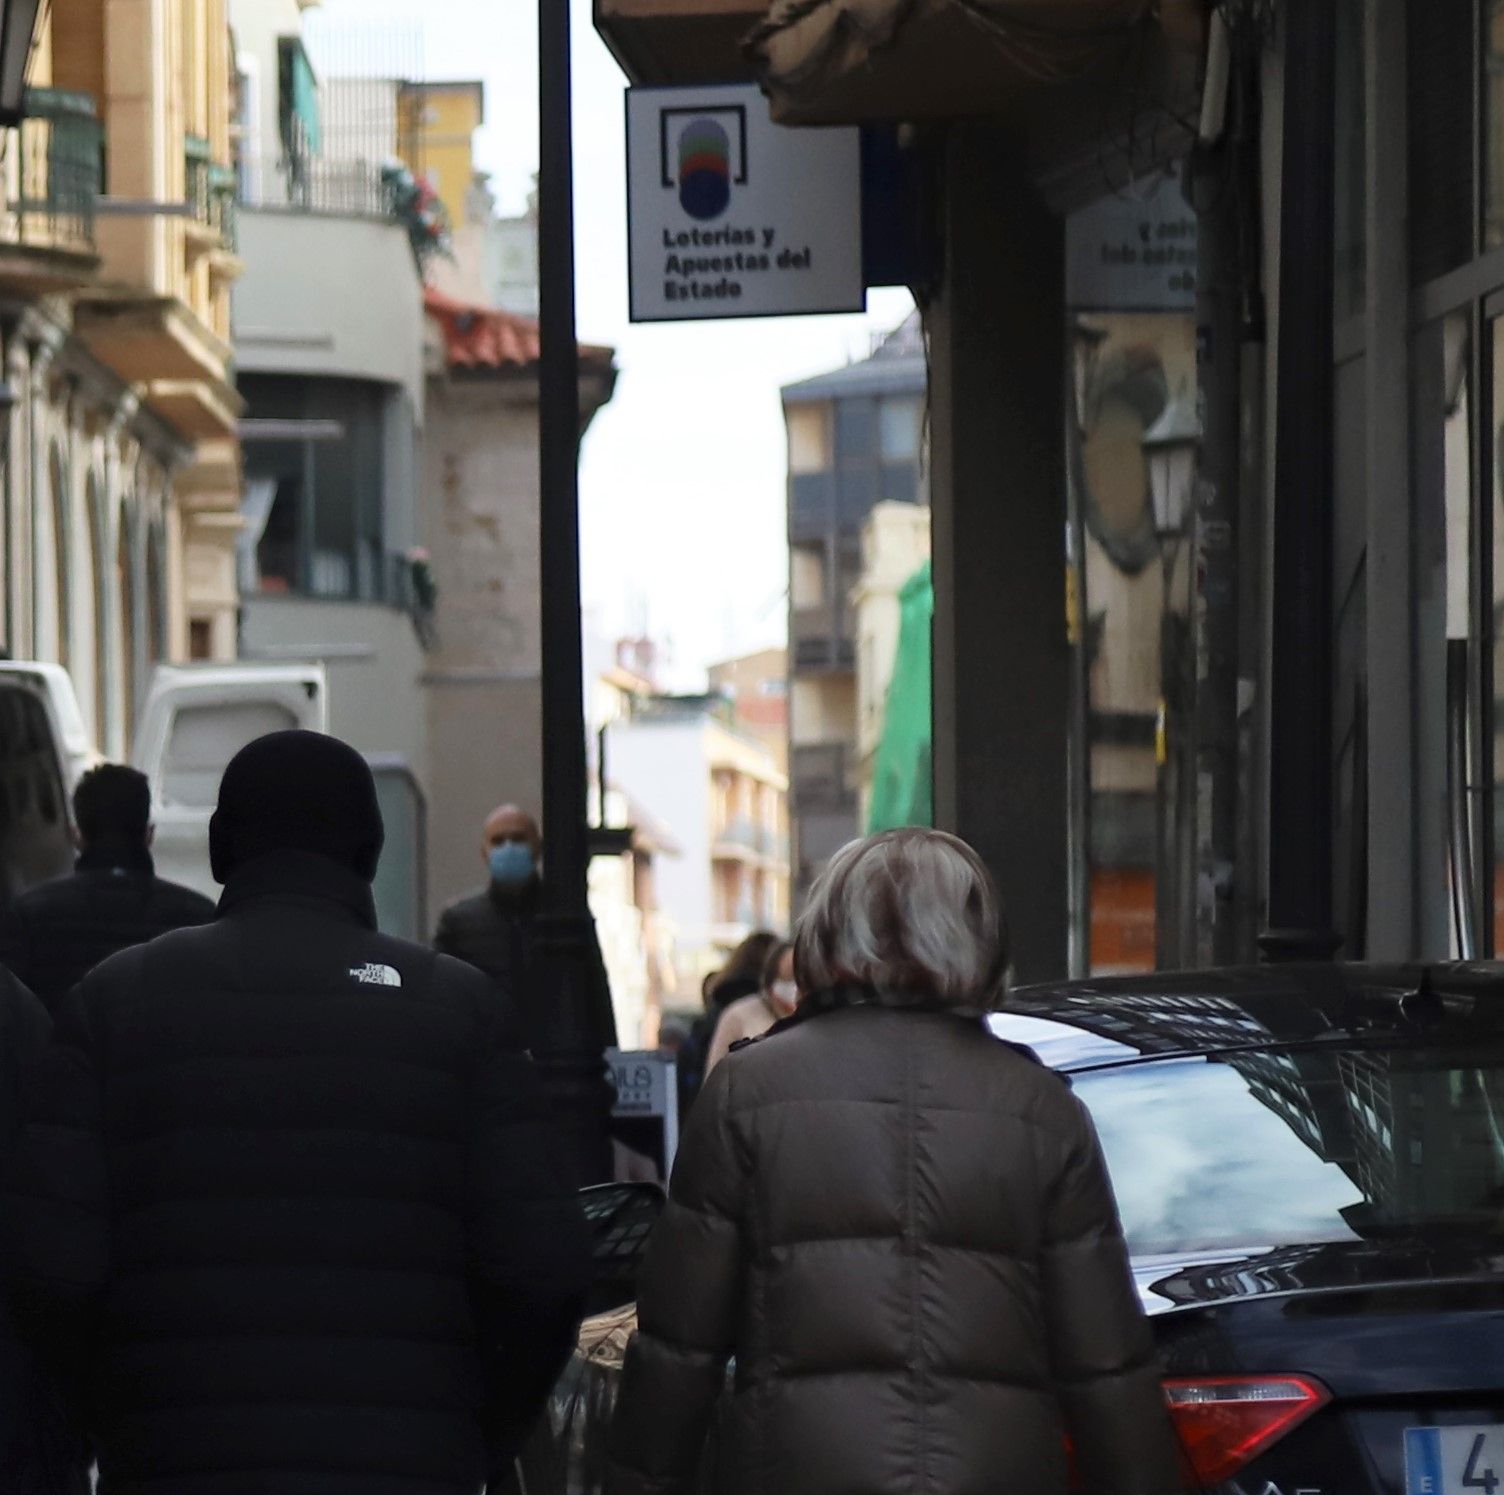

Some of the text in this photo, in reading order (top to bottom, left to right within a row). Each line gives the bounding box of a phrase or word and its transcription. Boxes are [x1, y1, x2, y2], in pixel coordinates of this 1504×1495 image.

[762, 228, 776, 249] y
[665, 246, 811, 278] Apuestas del
[664, 278, 743, 301] Estado
[1461, 1432, 1500, 1495] 4
[1420, 1475, 1434, 1494] E
